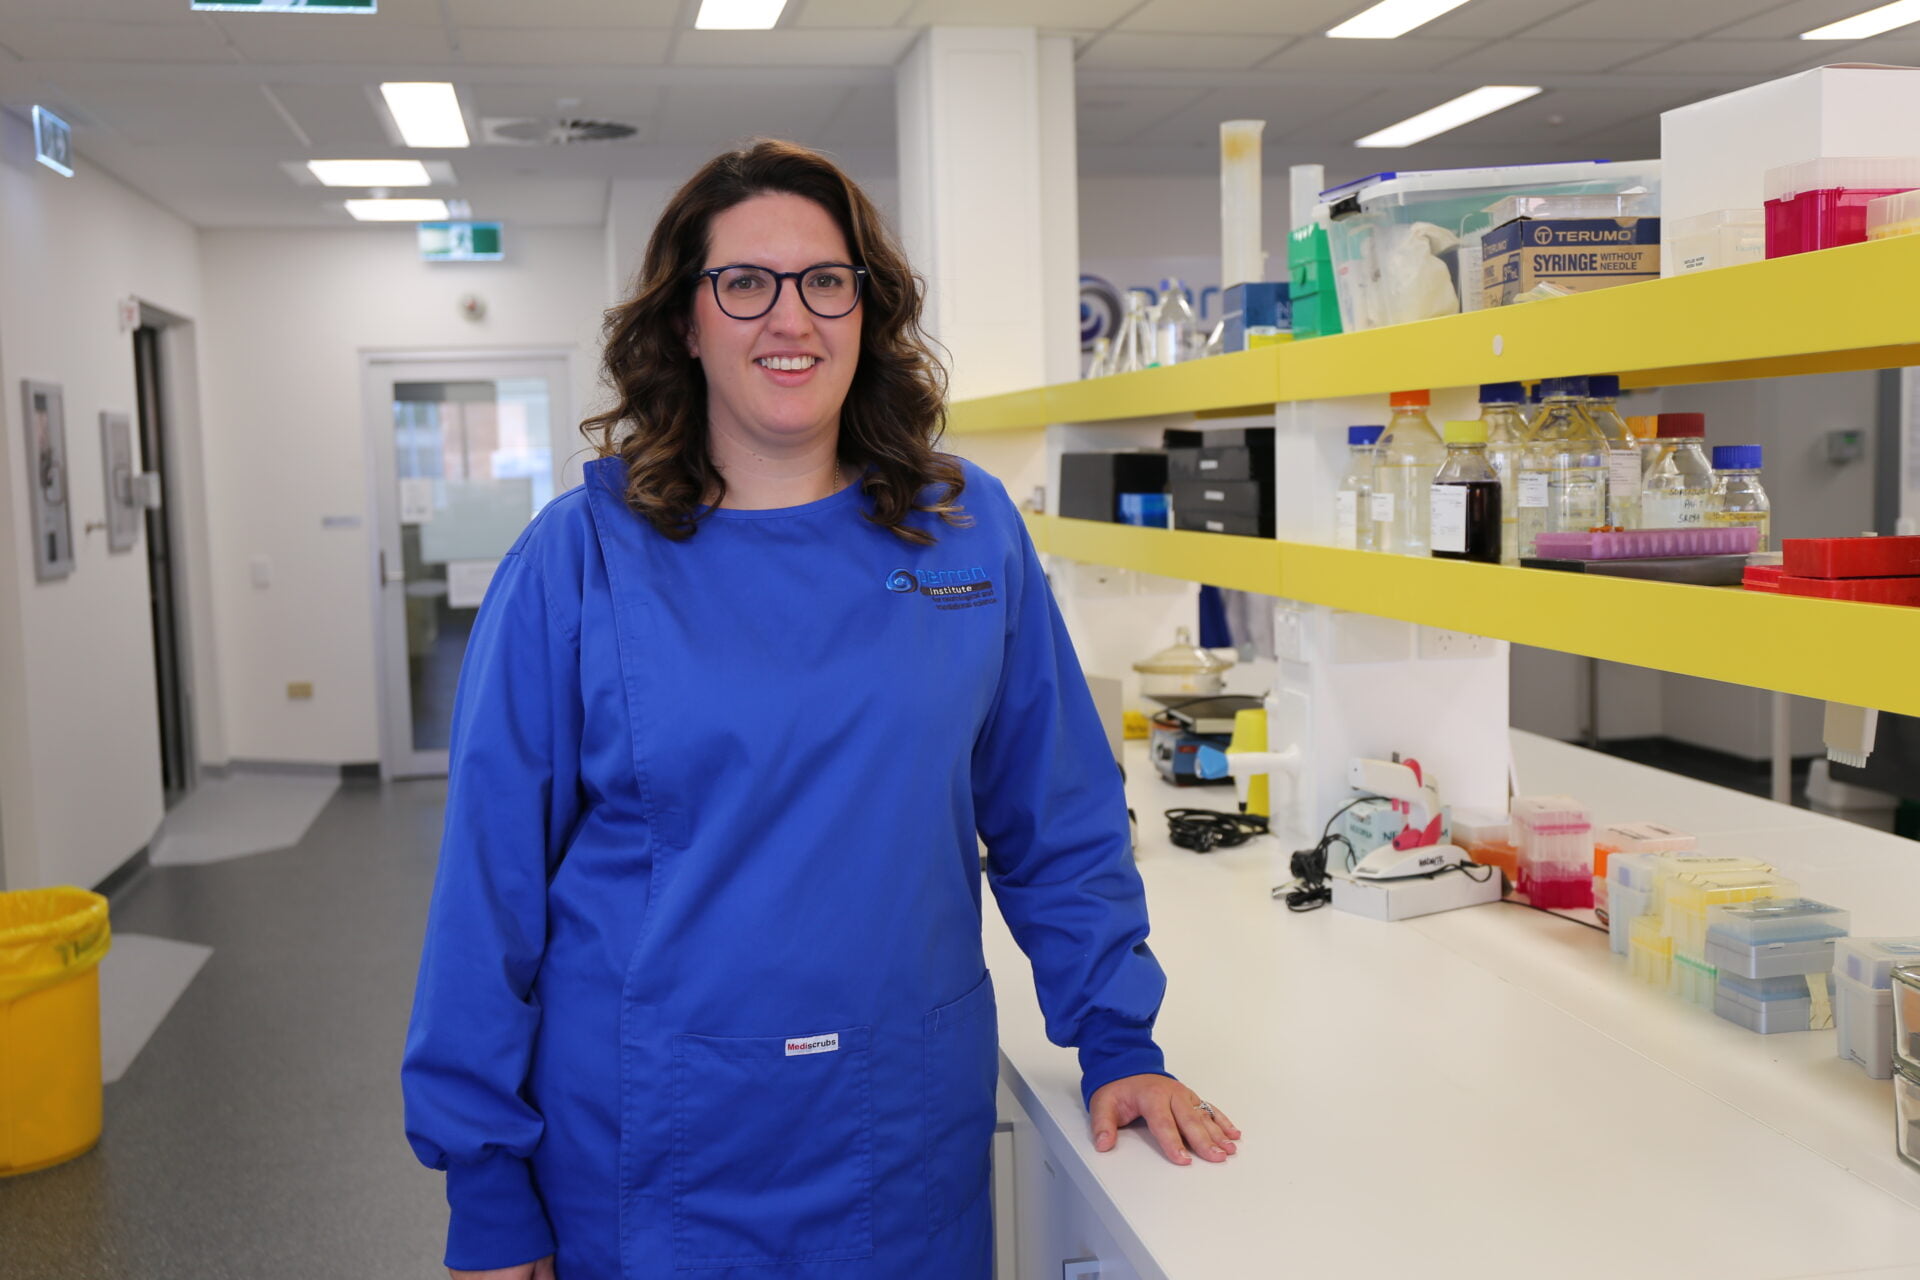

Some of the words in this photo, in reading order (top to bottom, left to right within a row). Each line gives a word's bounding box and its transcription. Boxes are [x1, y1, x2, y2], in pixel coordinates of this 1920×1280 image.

[1555, 230, 1632, 242] TERUMO
[1533, 253, 1598, 272] SYRINGE
[1600, 252, 1643, 261] WITHOUT
[1600, 262, 1637, 270] NEEDLE
[787, 1039, 837, 1051] Mediscrubs
